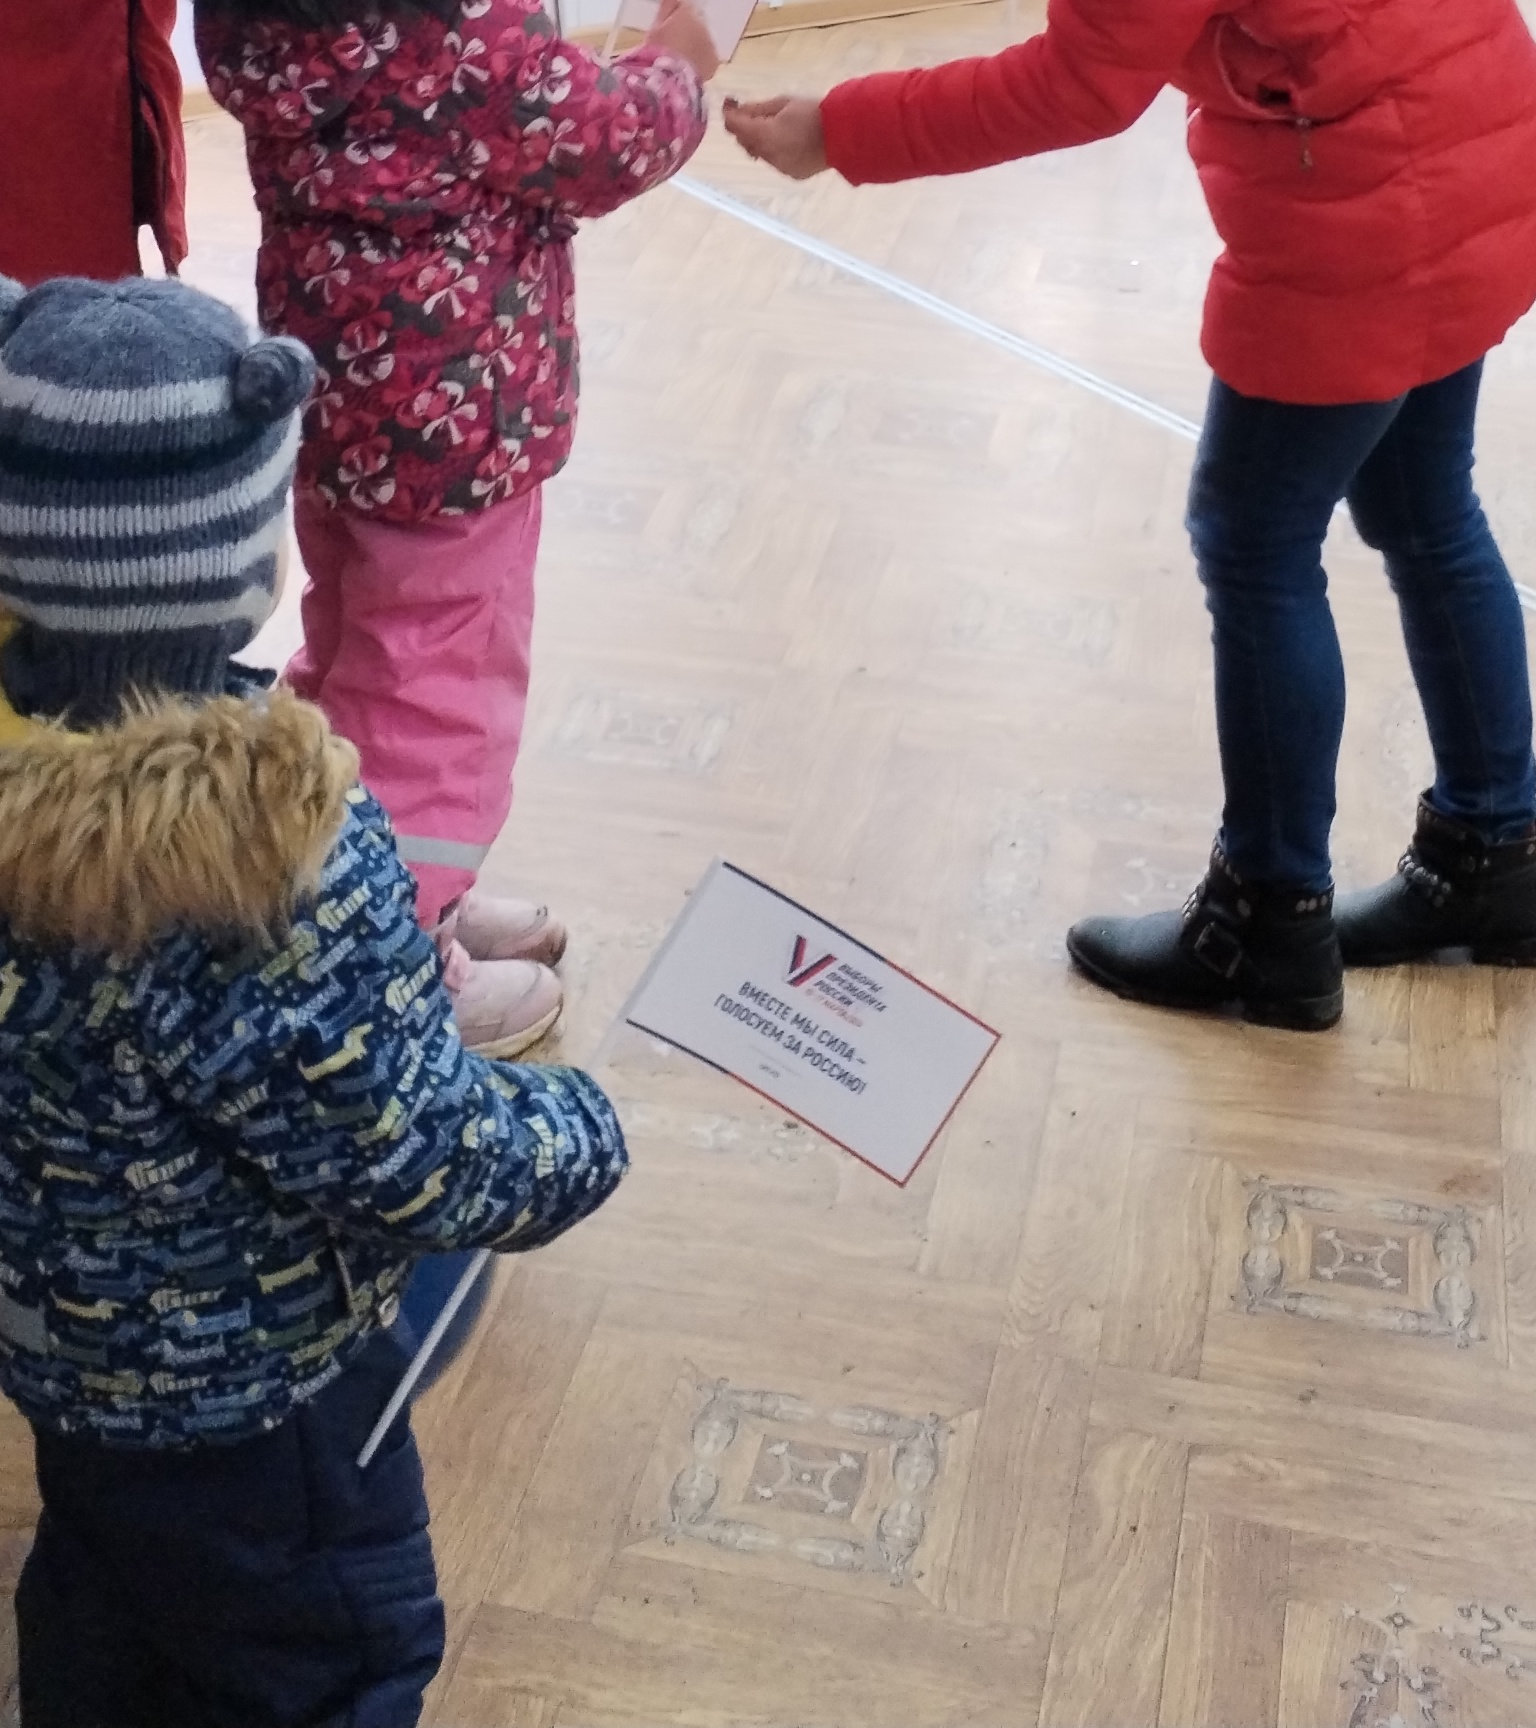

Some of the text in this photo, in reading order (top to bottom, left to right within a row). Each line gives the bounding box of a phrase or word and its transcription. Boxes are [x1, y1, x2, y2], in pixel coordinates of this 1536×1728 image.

[714, 993, 785, 1042] ГОЛОСУЕМ
[782, 1034, 803, 1055] ЗА
[801, 1046, 867, 1095] РОССИЮ!
[738, 981, 793, 1020] ВМЕСТЕ
[790, 1012, 819, 1037] МЫ
[817, 1030, 856, 1062] СИЛА
